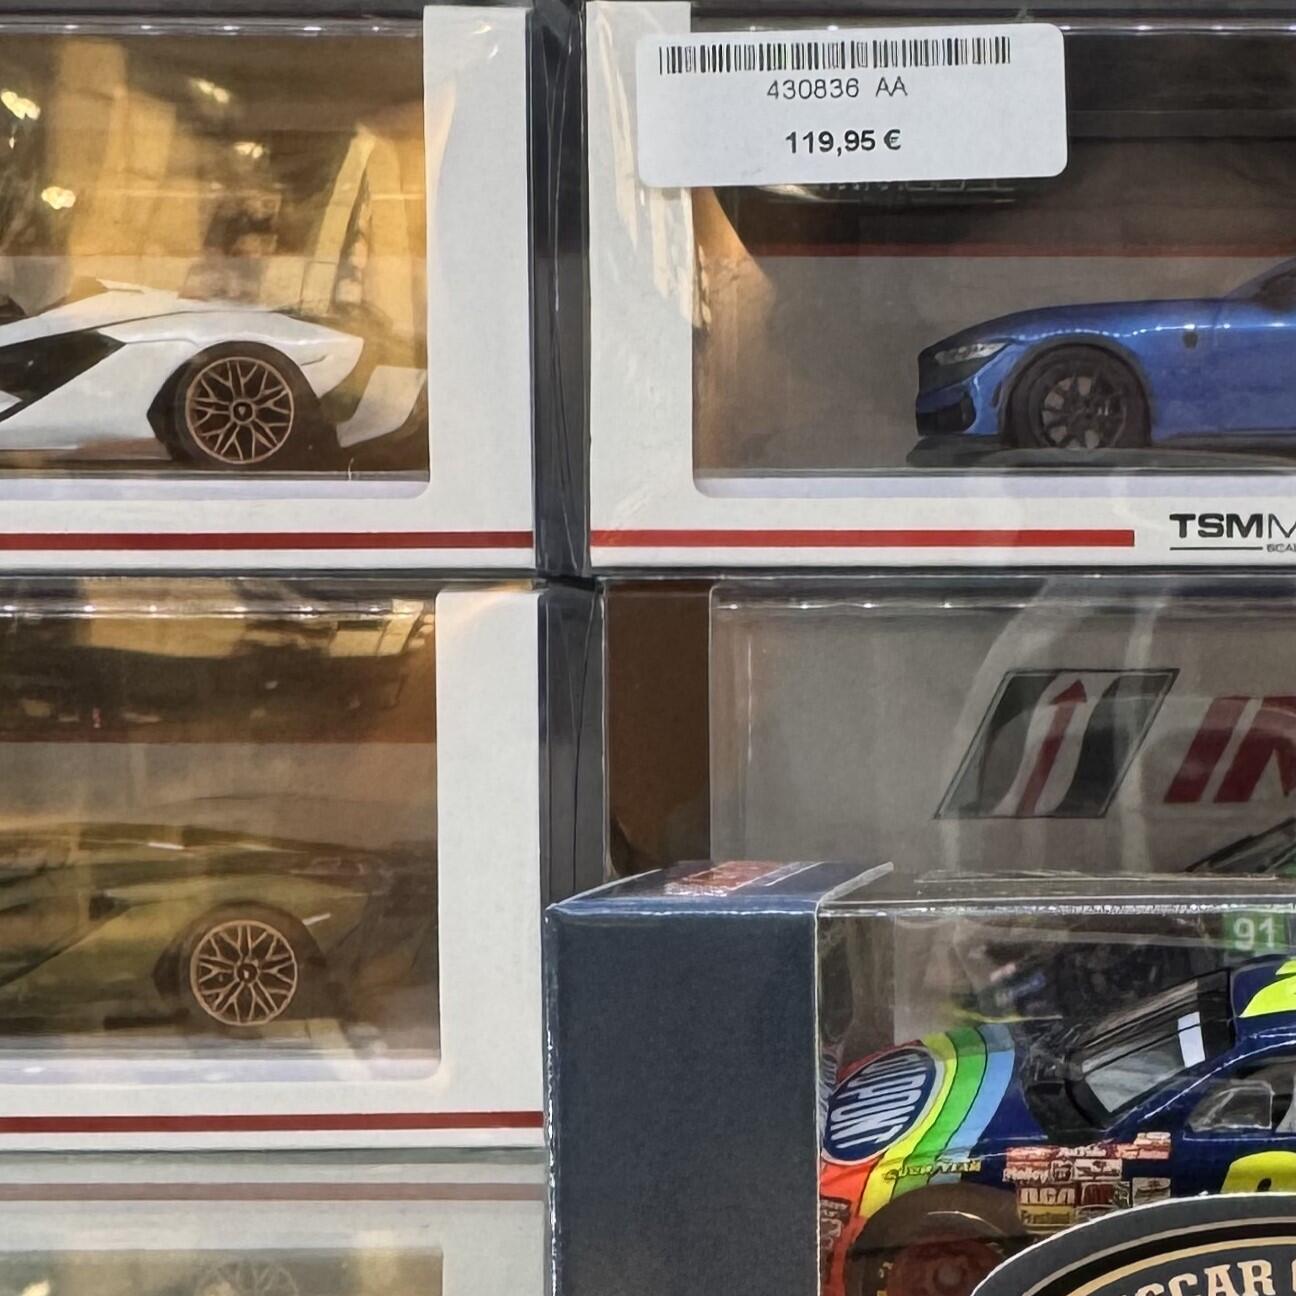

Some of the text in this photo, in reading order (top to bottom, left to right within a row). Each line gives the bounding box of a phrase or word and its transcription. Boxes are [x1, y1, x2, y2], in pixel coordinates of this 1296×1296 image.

[766, 75, 909, 100] 430836 AA
[785, 129, 901, 157] 119,95 €
[1232, 918, 1276, 950] 91
